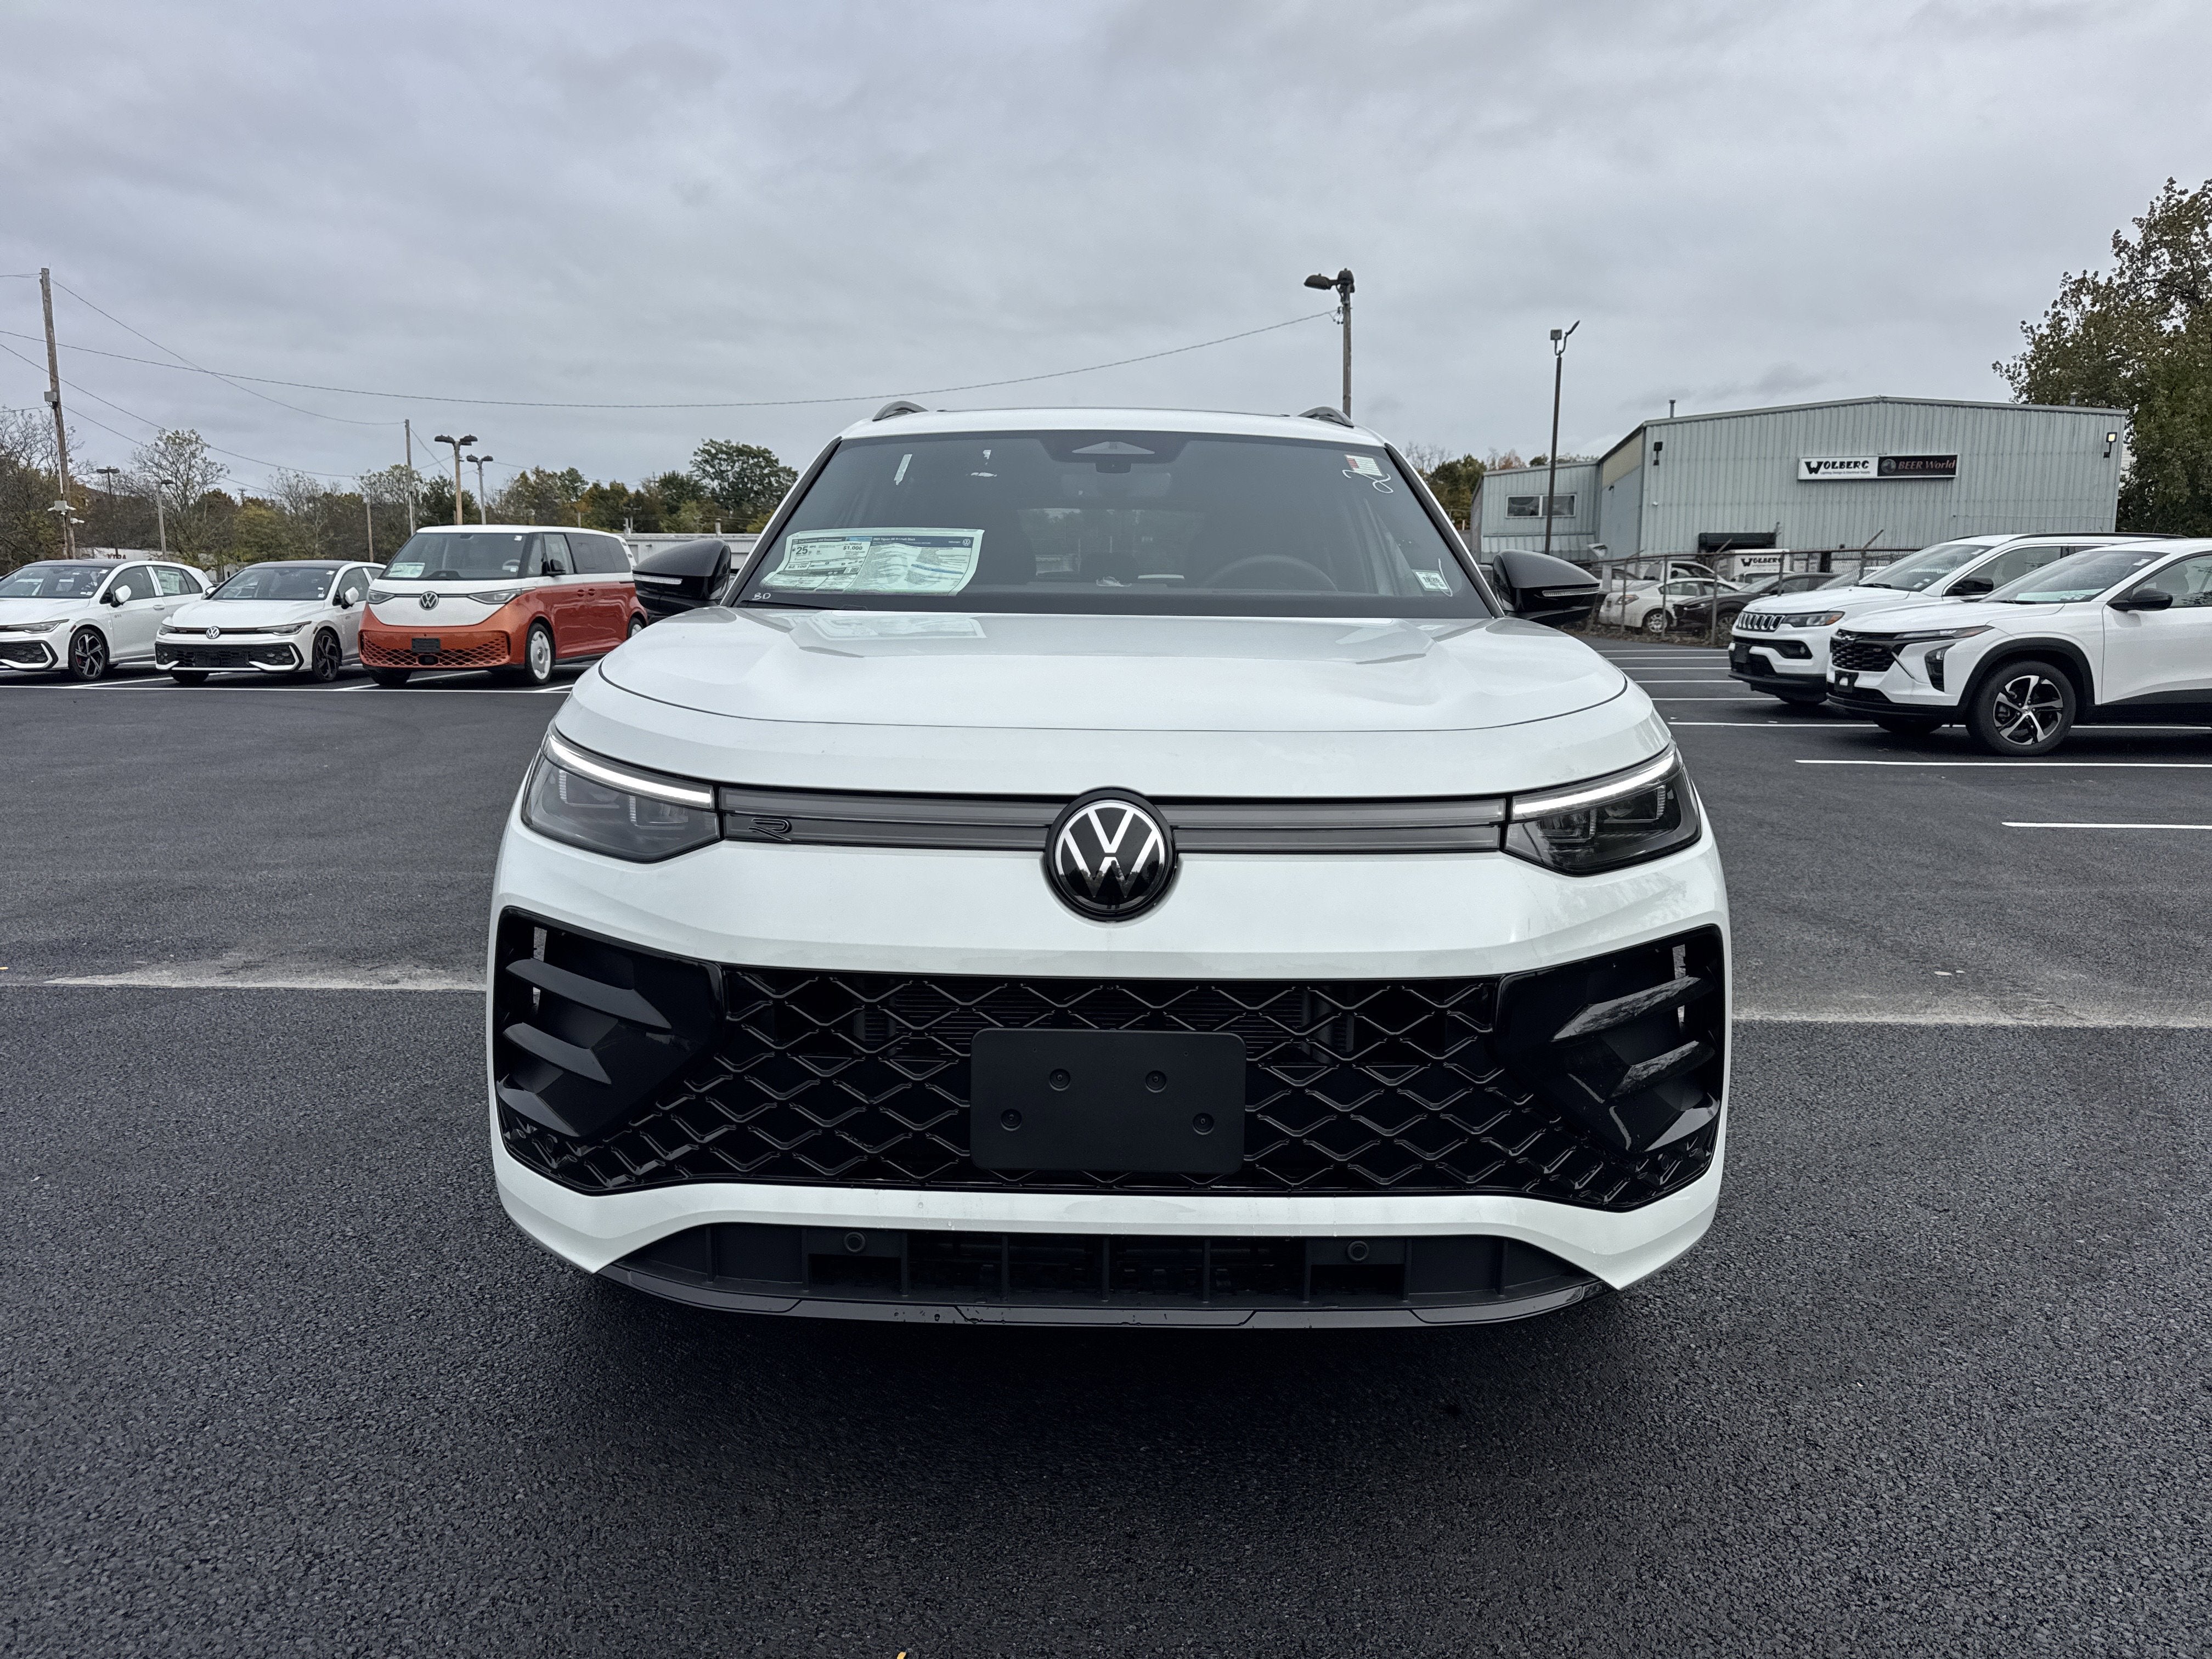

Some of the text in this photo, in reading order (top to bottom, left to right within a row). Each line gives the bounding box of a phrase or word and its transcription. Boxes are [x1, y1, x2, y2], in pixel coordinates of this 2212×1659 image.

[1898, 460, 1956, 470] BEER World
[795, 546, 808, 555] 25
